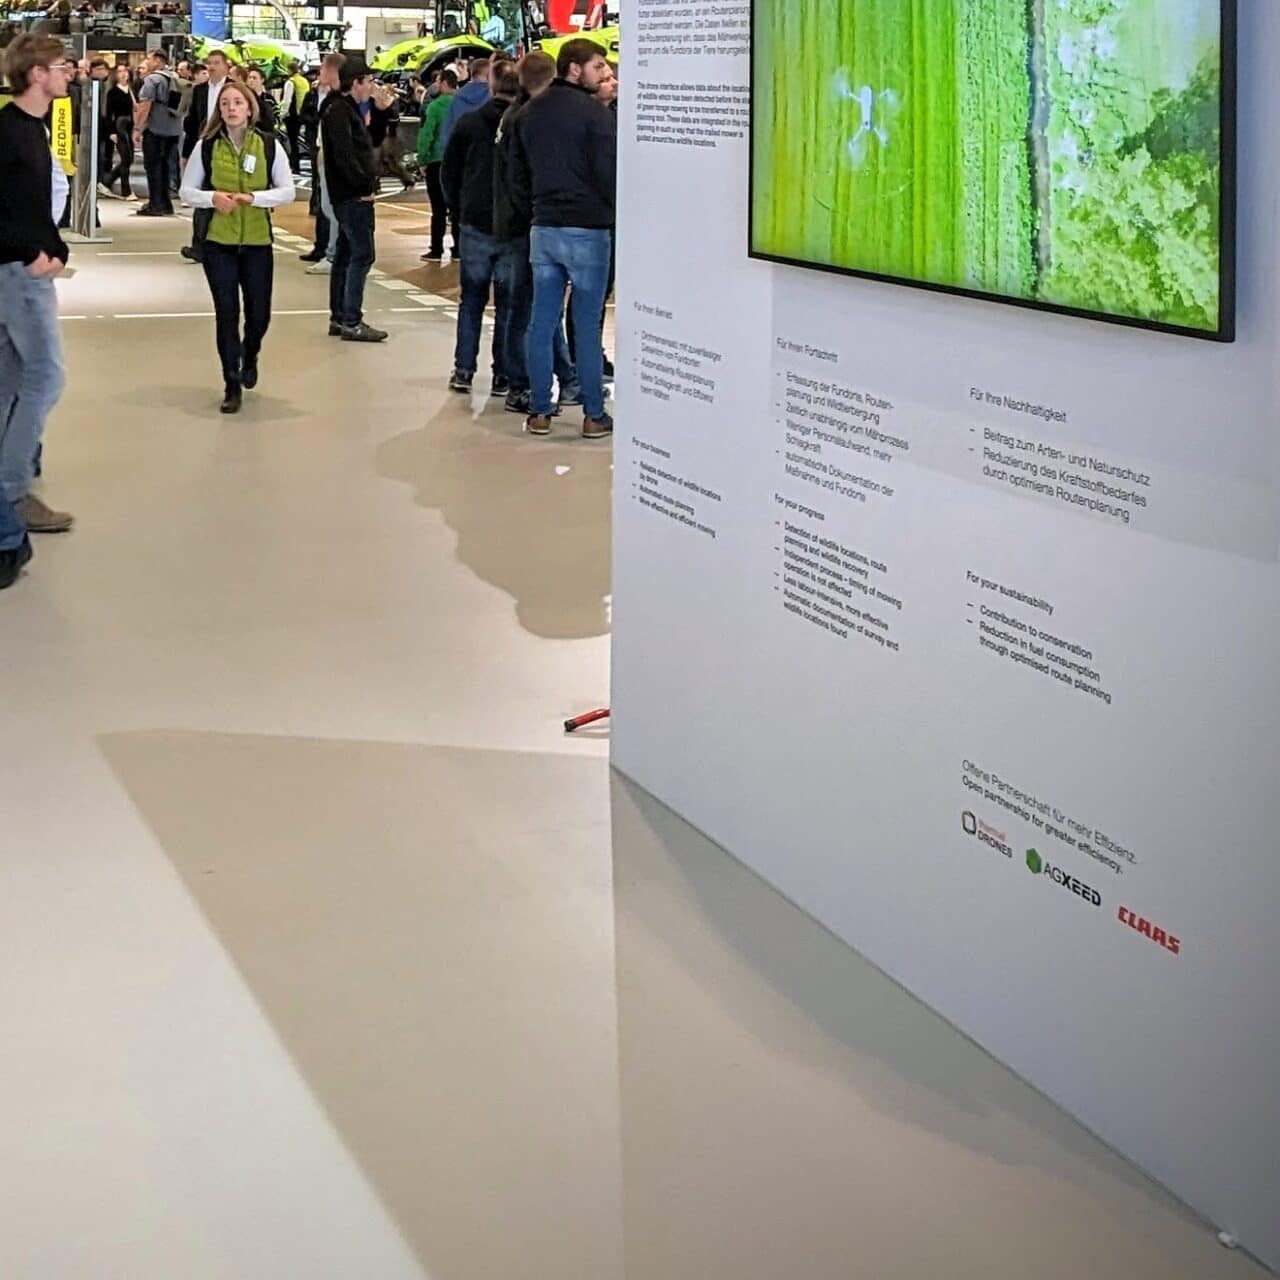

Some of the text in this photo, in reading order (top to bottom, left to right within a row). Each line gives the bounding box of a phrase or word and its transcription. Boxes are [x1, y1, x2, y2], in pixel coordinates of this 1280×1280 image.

[970, 388, 984, 400] Für
[986, 392, 1001, 406] Ihre
[984, 428, 1150, 486] Beitrag zum Arten- und Naturschutz
[984, 447, 1037, 476] Reduzierung
[1040, 466, 1056, 479] des
[785, 500, 797, 509] your
[983, 466, 1007, 480] durch
[1056, 486, 1129, 523] Routenplanung
[785, 521, 810, 539] Detection
[820, 538, 839, 552] wildlife
[809, 546, 819, 556] and
[821, 552, 840, 565] wildlife
[967, 570, 1053, 615] For your sustainability
[980, 605, 1092, 660] Contribution to conservation
[980, 621, 1100, 682] Reduction in fuel consumption
[980, 636, 1008, 656] through
[1051, 669, 1072, 684] route
[1074, 680, 1111, 704] planning
[962, 776, 982, 794] Open
[985, 790, 1030, 820] partnership
[1032, 814, 1044, 827] for
[1045, 824, 1076, 846] greater
[1053, 808, 1065, 823] für
[1068, 819, 1092, 838] mehr
[977, 829, 1013, 858] DRONES
[1044, 862, 1101, 907] AGXEED
[1118, 905, 1180, 955] CLAAS
